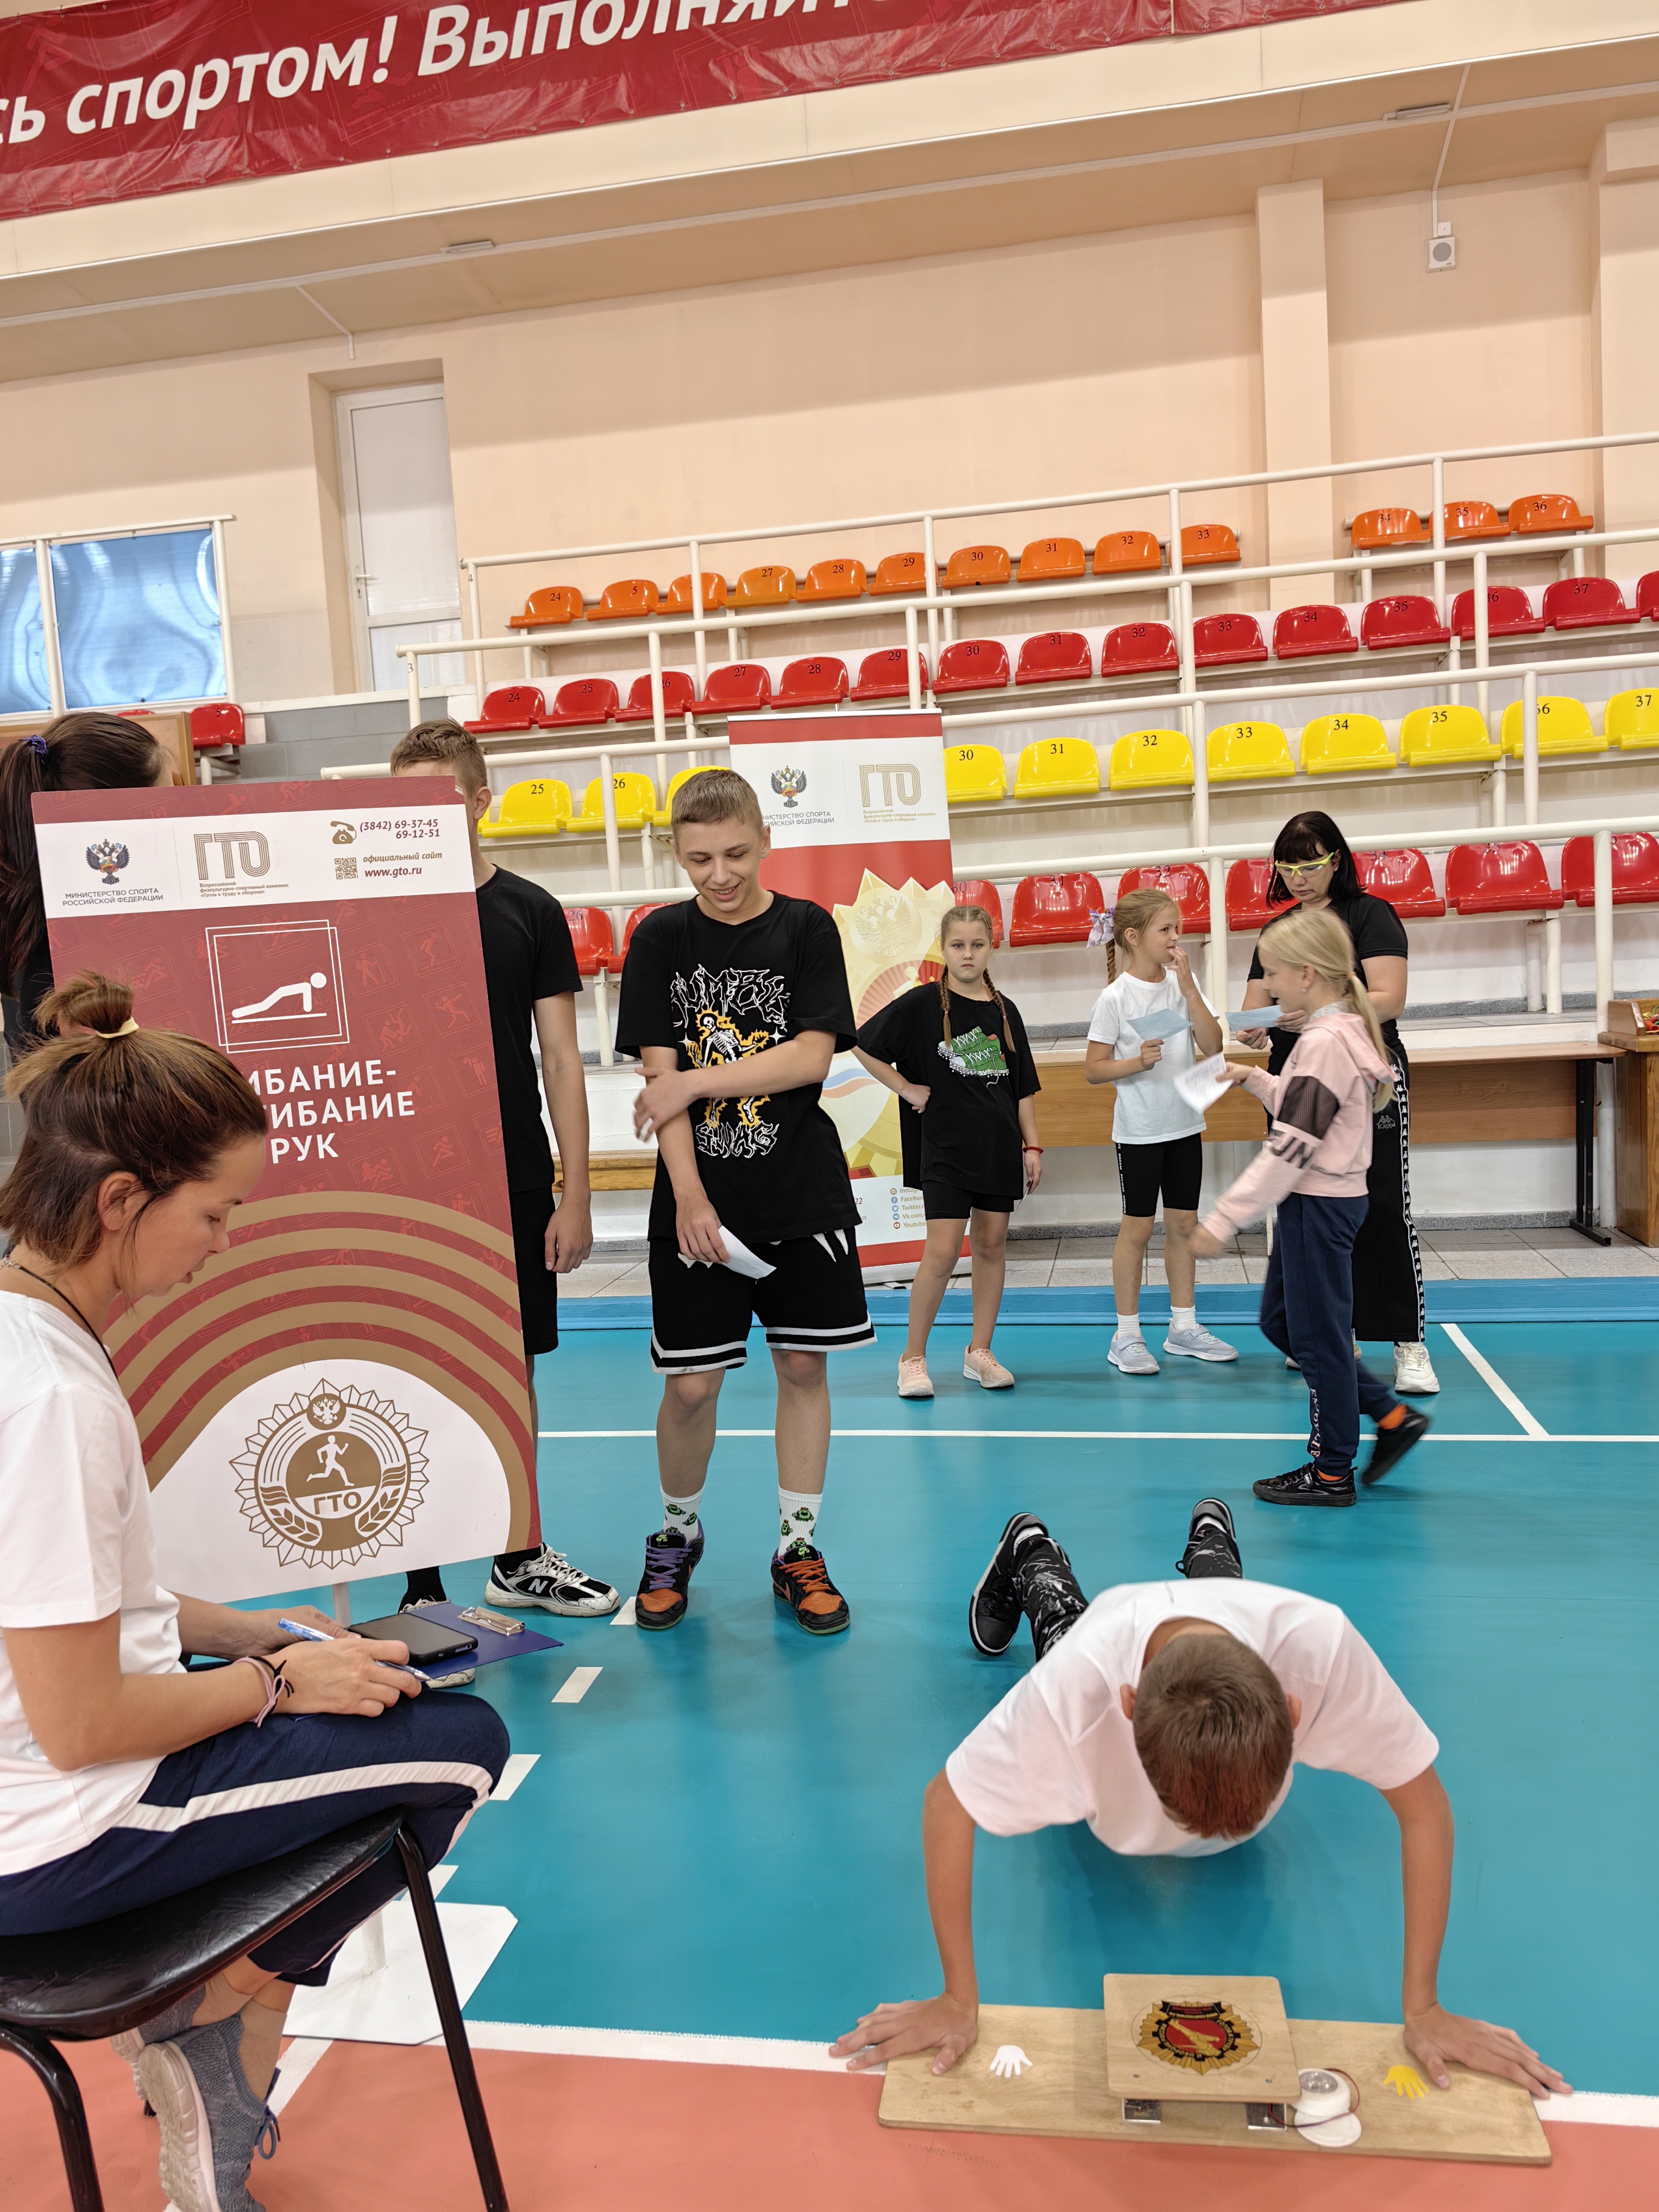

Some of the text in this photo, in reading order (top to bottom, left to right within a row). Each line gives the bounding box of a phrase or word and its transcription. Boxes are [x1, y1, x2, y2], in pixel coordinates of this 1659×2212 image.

[67, 15, 398, 135] спортом!
[1533, 502, 1546, 511] 36
[1456, 507, 1468, 517] 35
[1379, 514, 1391, 522] 34
[1198, 530, 1209, 539] 33
[1121, 535, 1133, 545] 32
[1046, 543, 1056, 552] 31
[903, 557, 915, 566] 29
[762, 568, 773, 577] 27
[833, 565, 843, 573] 28
[468, 574, 473, 582] 4
[1574, 584, 1588, 594] 37
[550, 593, 560, 601] 24
[1395, 601, 1407, 612] 35
[1304, 612, 1317, 622] 34
[1219, 621, 1232, 632] 33
[1133, 627, 1145, 637] 32
[1050, 635, 1061, 645] 31
[888, 651, 901, 660] 29
[967, 646, 979, 656] 30
[408, 663, 413, 673] 3
[734, 666, 746, 677] 27
[808, 664, 821, 674] 28
[582, 684, 592, 693] 25
[662, 679, 670, 688] 6
[509, 693, 519, 702] 24
[1636, 695, 1651, 707] 37
[1432, 711, 1447, 722] 35
[1334, 719, 1349, 730] 34
[1237, 727, 1252, 738] 33
[1143, 735, 1157, 746] 32
[1051, 744, 1063, 754] 31
[959, 750, 973, 760] 30
[531, 784, 544, 794] 25
[613, 779, 625, 789] 26
[859, 763, 921, 807] ГТО
[360, 819, 438, 833] (3842) 69-37-45
[396, 829, 440, 839] 69-12-51
[194, 831, 270, 880] ГТО
[363, 852, 419, 864] официальный
[365, 867, 422, 878] www.gto.ru
[65, 890, 127, 899] МИНИСТЕРСТВО
[62, 898, 116, 906] РОССИЙСКОЙ
[568, 910, 583, 921] 26
[248, 1060, 396, 1095] ИБАНИЕ-
[270, 1091, 415, 1129] ИБАНИЕ
[696, 1120, 780, 1159] SWAG
[270, 1133, 339, 1164] РУК
[314, 1491, 362, 1515] ГТО
[528, 1578, 549, 1593] N
